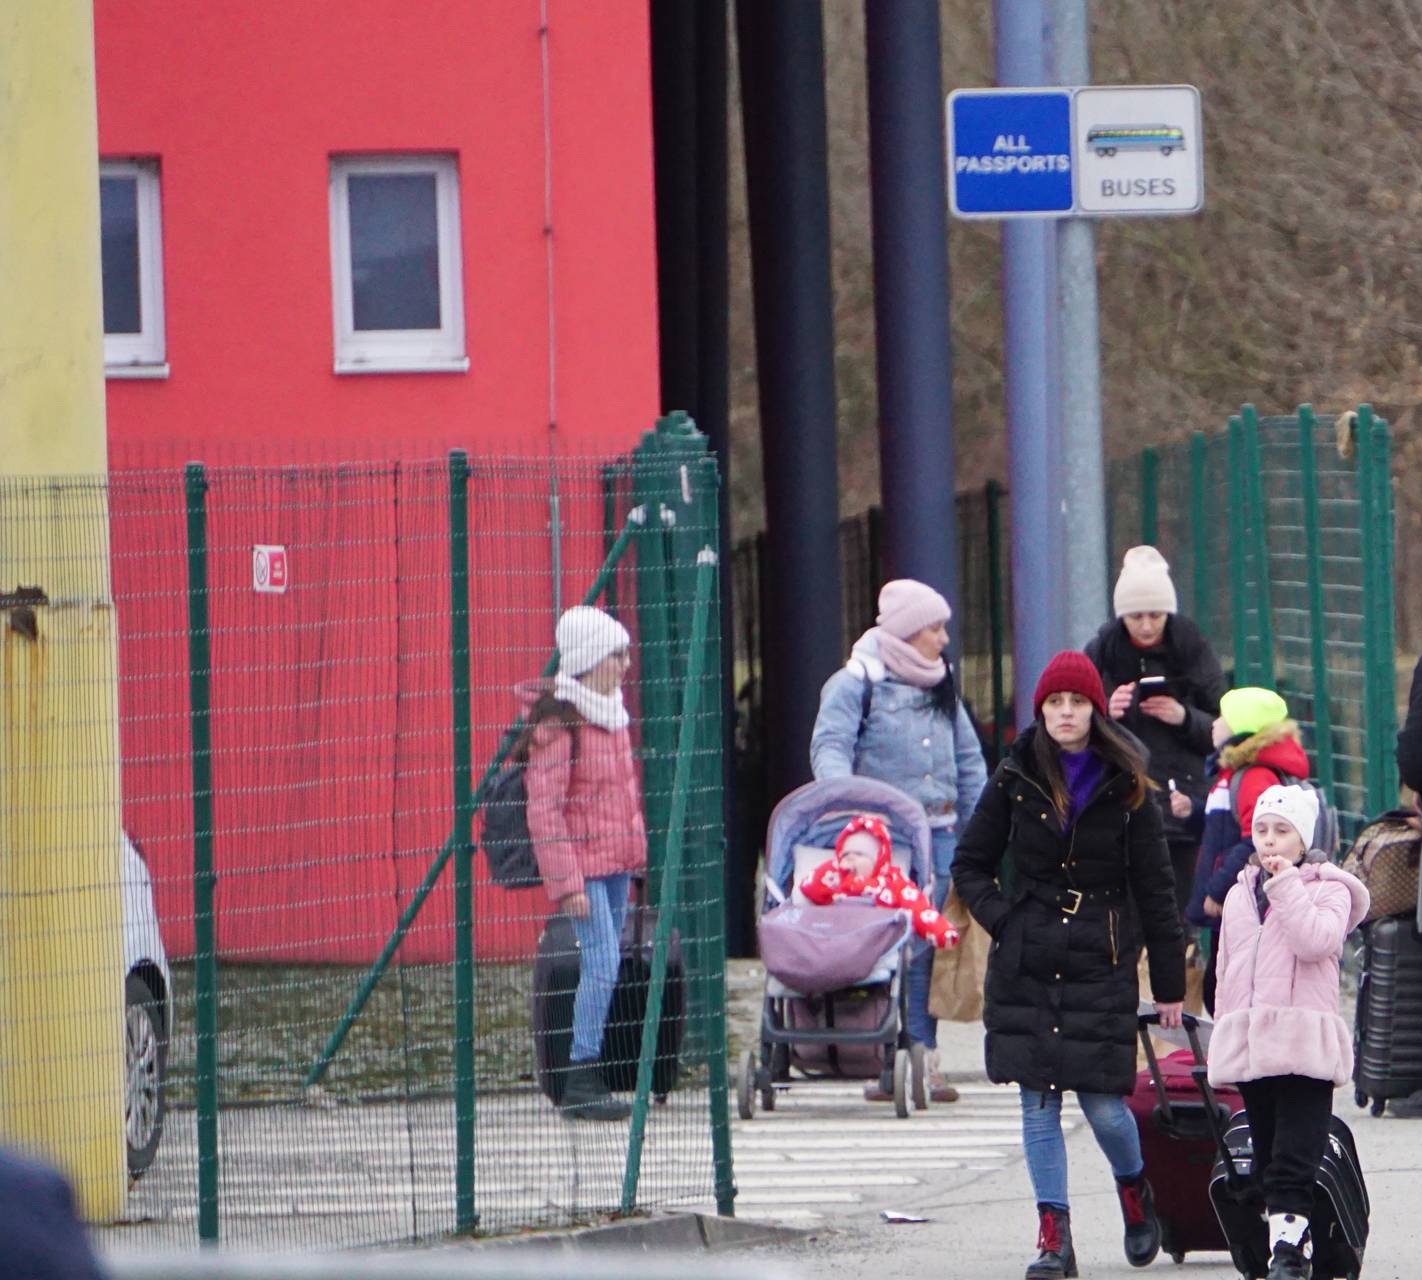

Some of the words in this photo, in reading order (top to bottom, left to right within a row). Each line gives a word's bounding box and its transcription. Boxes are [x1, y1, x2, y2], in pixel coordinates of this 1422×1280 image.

[992, 134, 1031, 153] ALL
[955, 154, 1070, 174] PASSPORTS
[1101, 178, 1176, 197] BUSES
